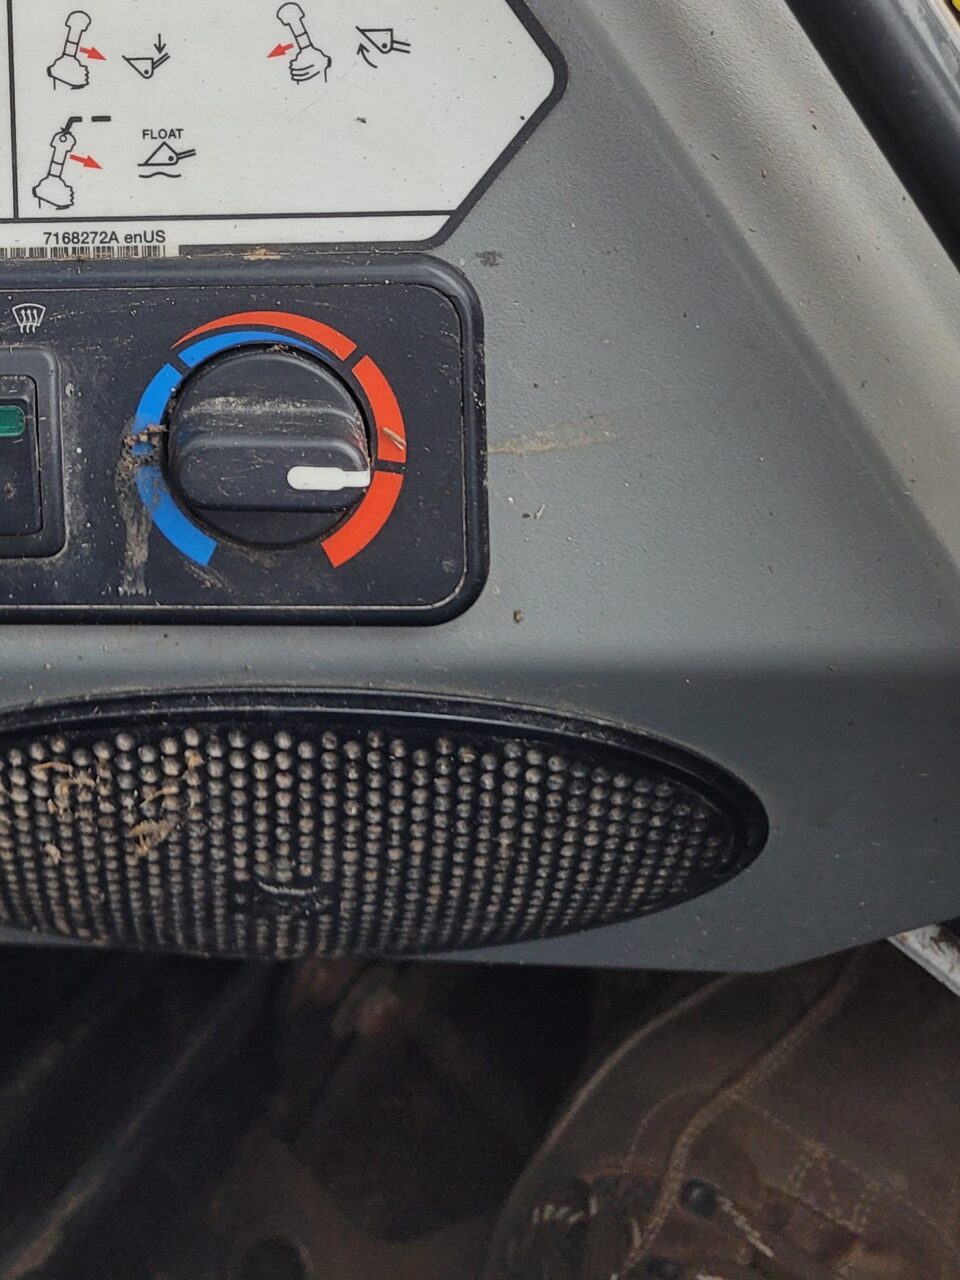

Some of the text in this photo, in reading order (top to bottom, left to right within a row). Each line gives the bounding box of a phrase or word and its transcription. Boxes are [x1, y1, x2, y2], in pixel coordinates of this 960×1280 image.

[142, 129, 184, 140] FLOAT
[43, 230, 165, 247] 7168272A enUS
